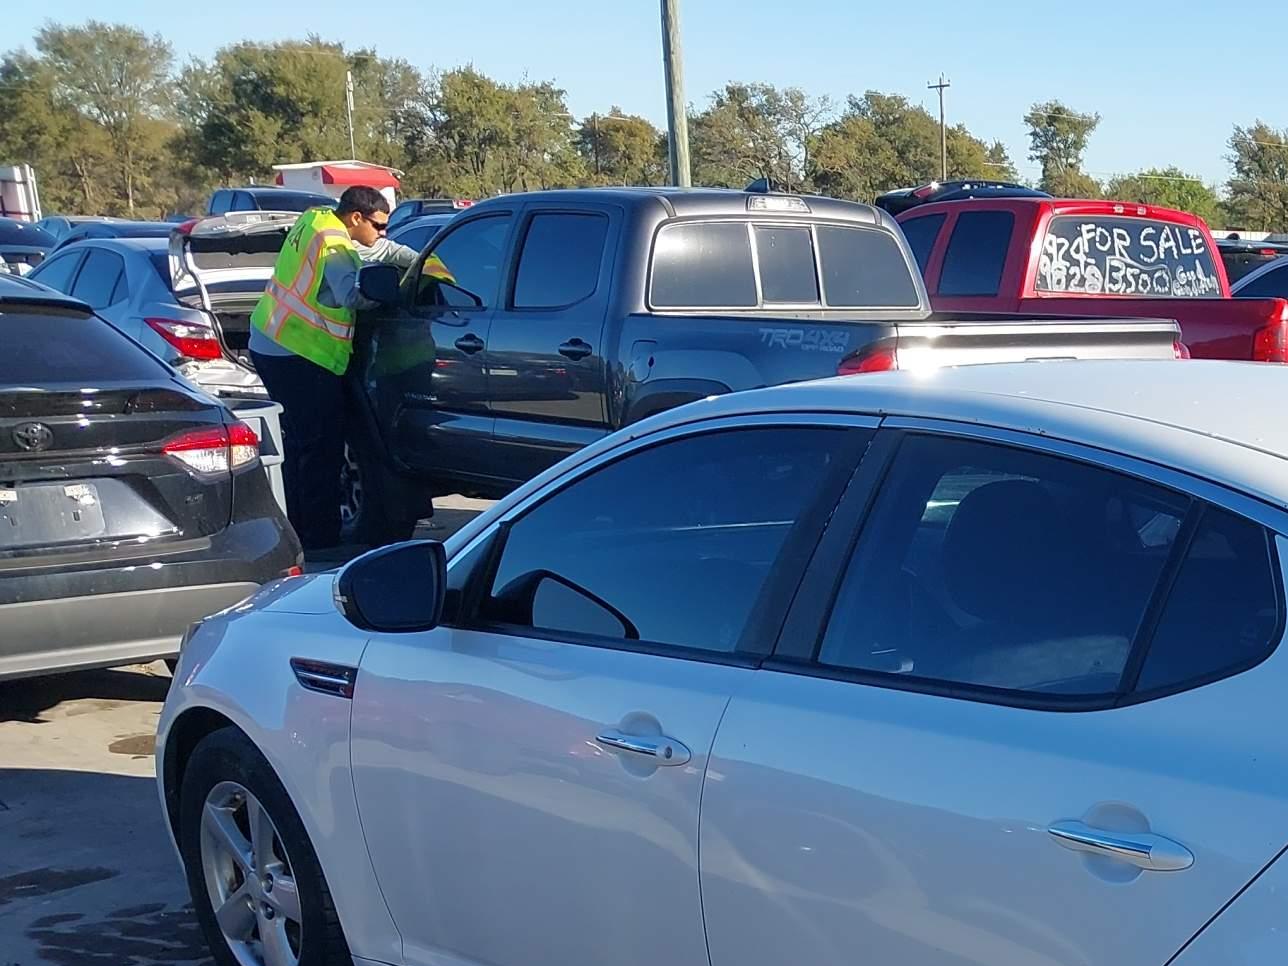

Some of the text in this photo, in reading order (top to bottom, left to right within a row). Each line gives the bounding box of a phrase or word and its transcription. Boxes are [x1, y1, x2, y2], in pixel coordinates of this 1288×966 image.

[1081, 224, 1205, 263] FOR SALE
[759, 327, 804, 349] TRD
